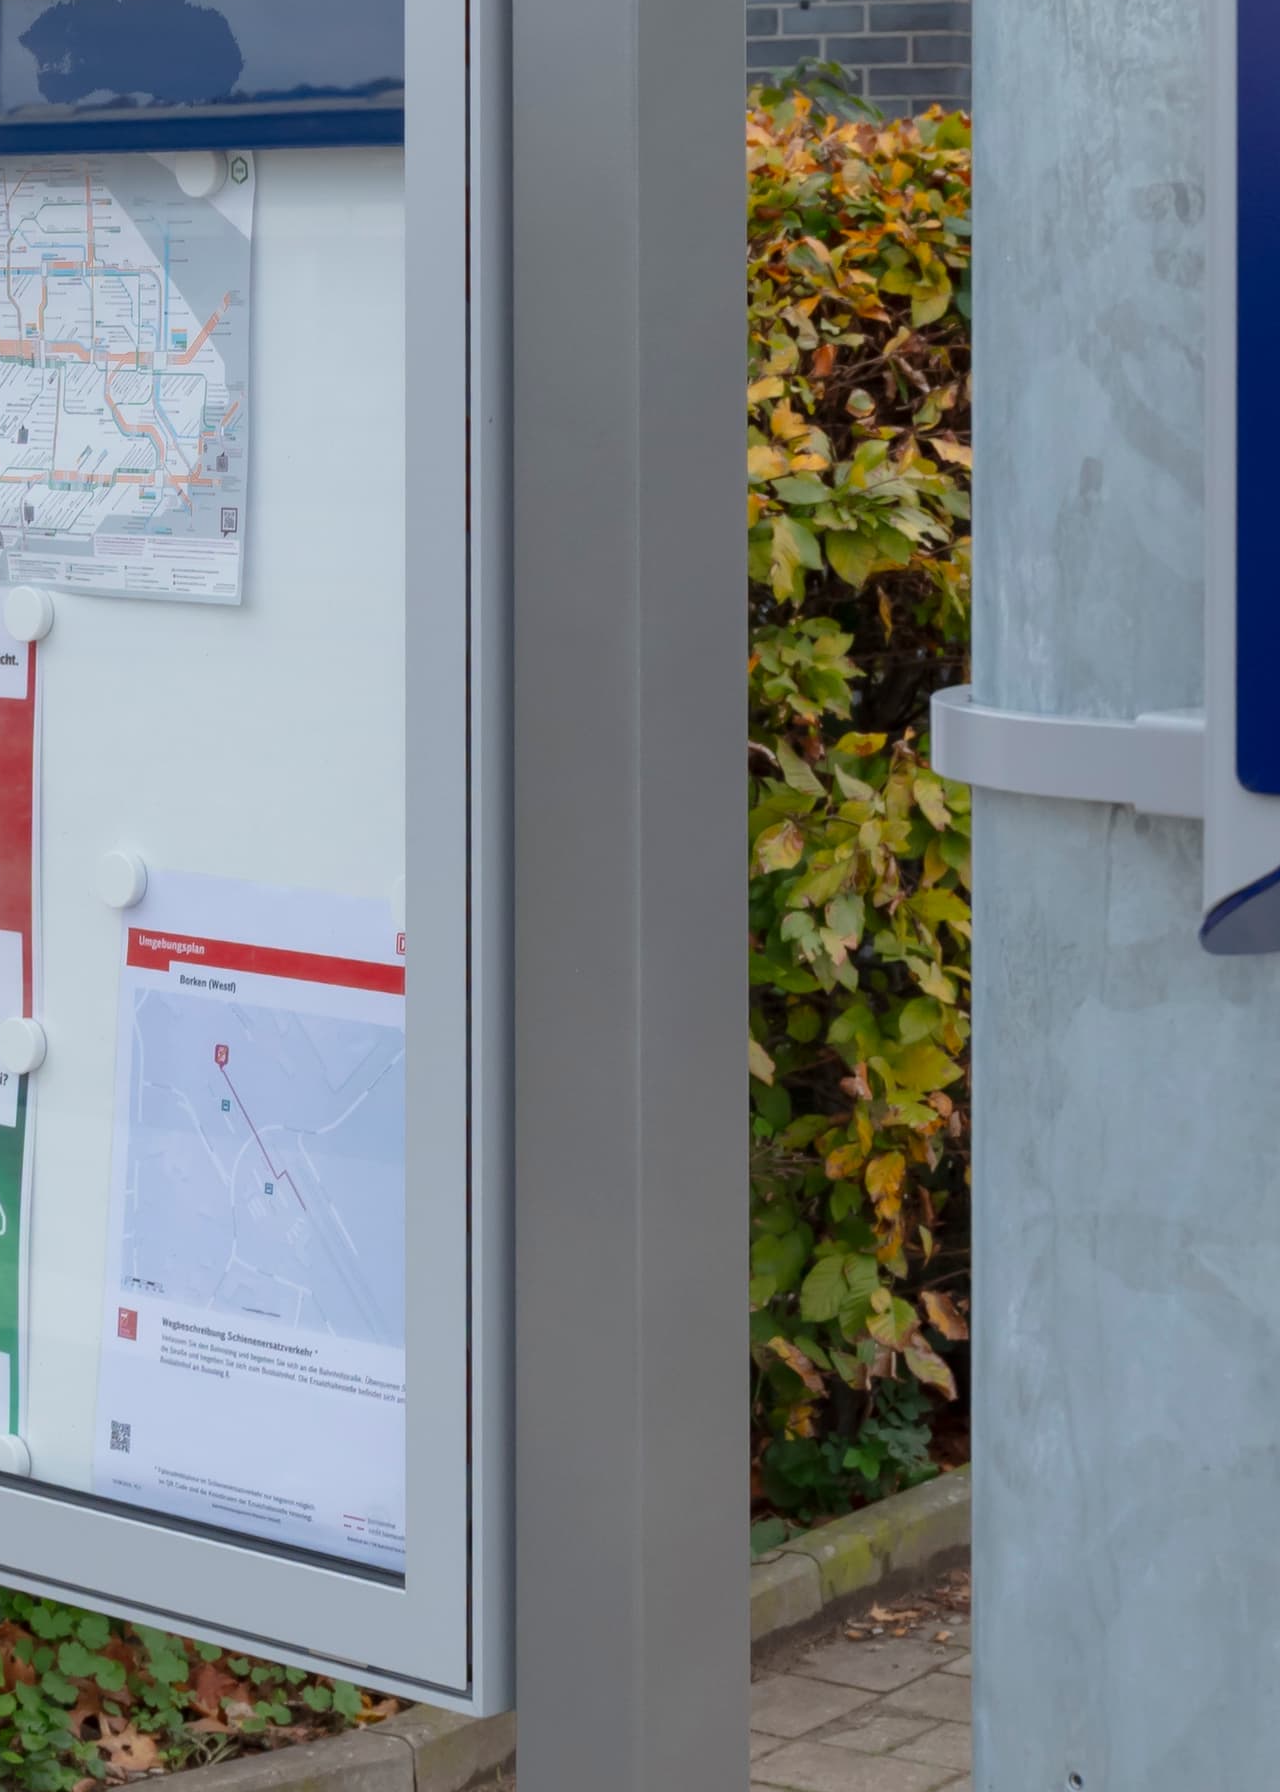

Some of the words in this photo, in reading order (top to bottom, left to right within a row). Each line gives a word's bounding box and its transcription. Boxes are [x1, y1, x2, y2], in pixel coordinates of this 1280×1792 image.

[138, 935, 205, 956] Umgebungsplan
[180, 974, 207, 988] Borken
[208, 978, 237, 994] (Westf)
[162, 1317, 226, 1341] Wegbeschreibung
[227, 1331, 313, 1357] Schienenersatzverkehr
